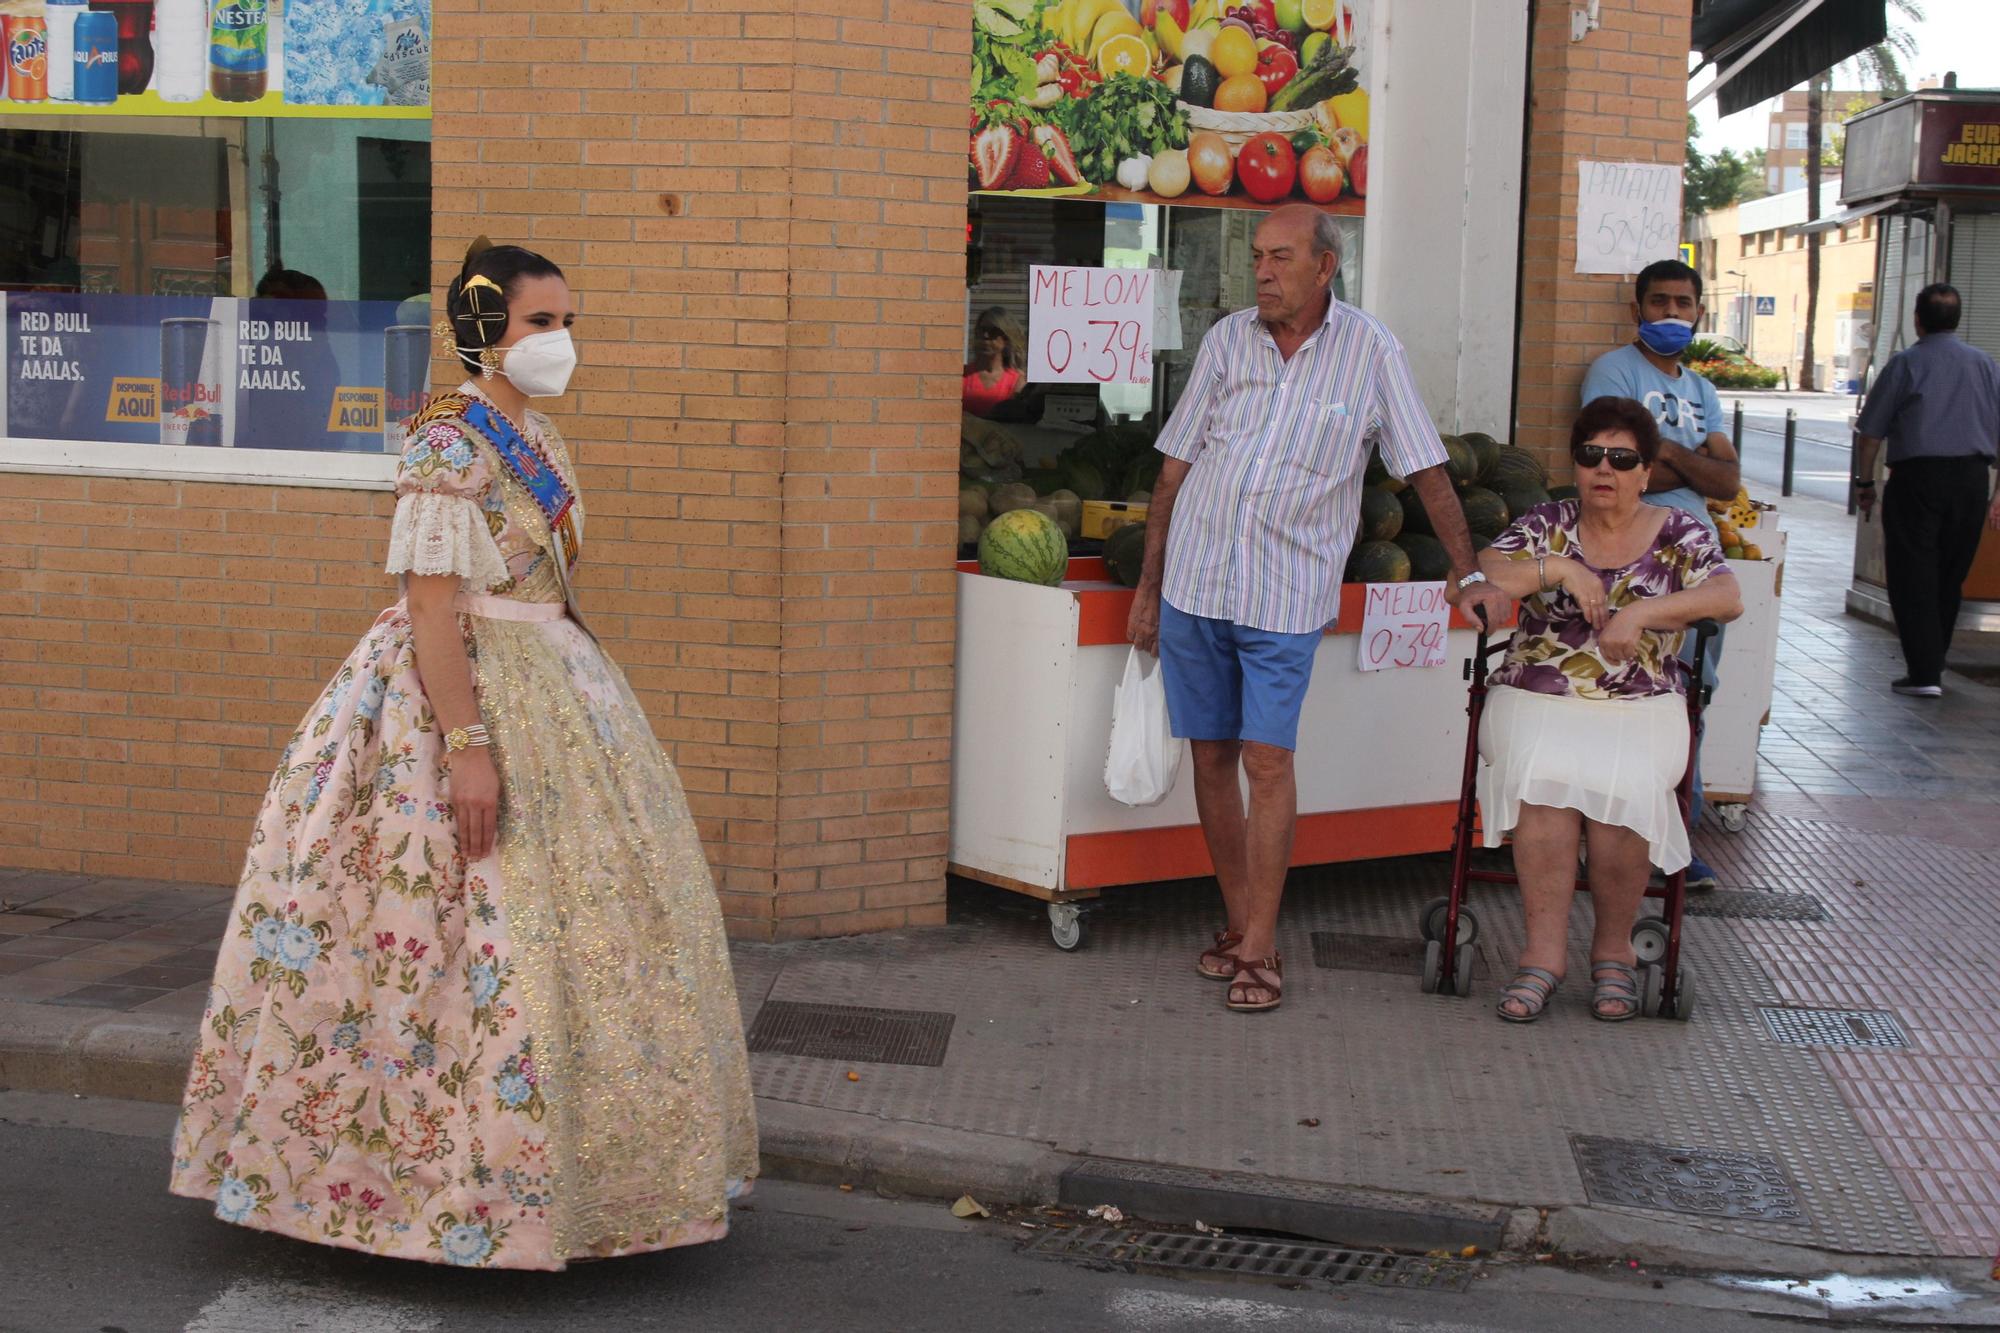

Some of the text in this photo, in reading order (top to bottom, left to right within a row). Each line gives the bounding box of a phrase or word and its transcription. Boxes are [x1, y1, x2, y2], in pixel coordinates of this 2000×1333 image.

[215, 9, 268, 25] NESTEA
[1034, 269, 1149, 307] MELON
[20, 311, 91, 333] RED BULL
[240, 320, 312, 342] RED BULL
[20, 335, 63, 356] TE DA
[239, 344, 283, 366] TE DA
[20, 359, 86, 381] AAALAS.
[239, 369, 306, 392] AAALAS.
[116, 383, 155, 394] DISPONIBLE
[162, 382, 222, 403] Red Bull
[338, 392, 379, 403] DISPONIBLE
[117, 394, 155, 417] AQUÍ
[338, 403, 379, 428] AQUÍ
[1367, 586, 1446, 616] MELON
